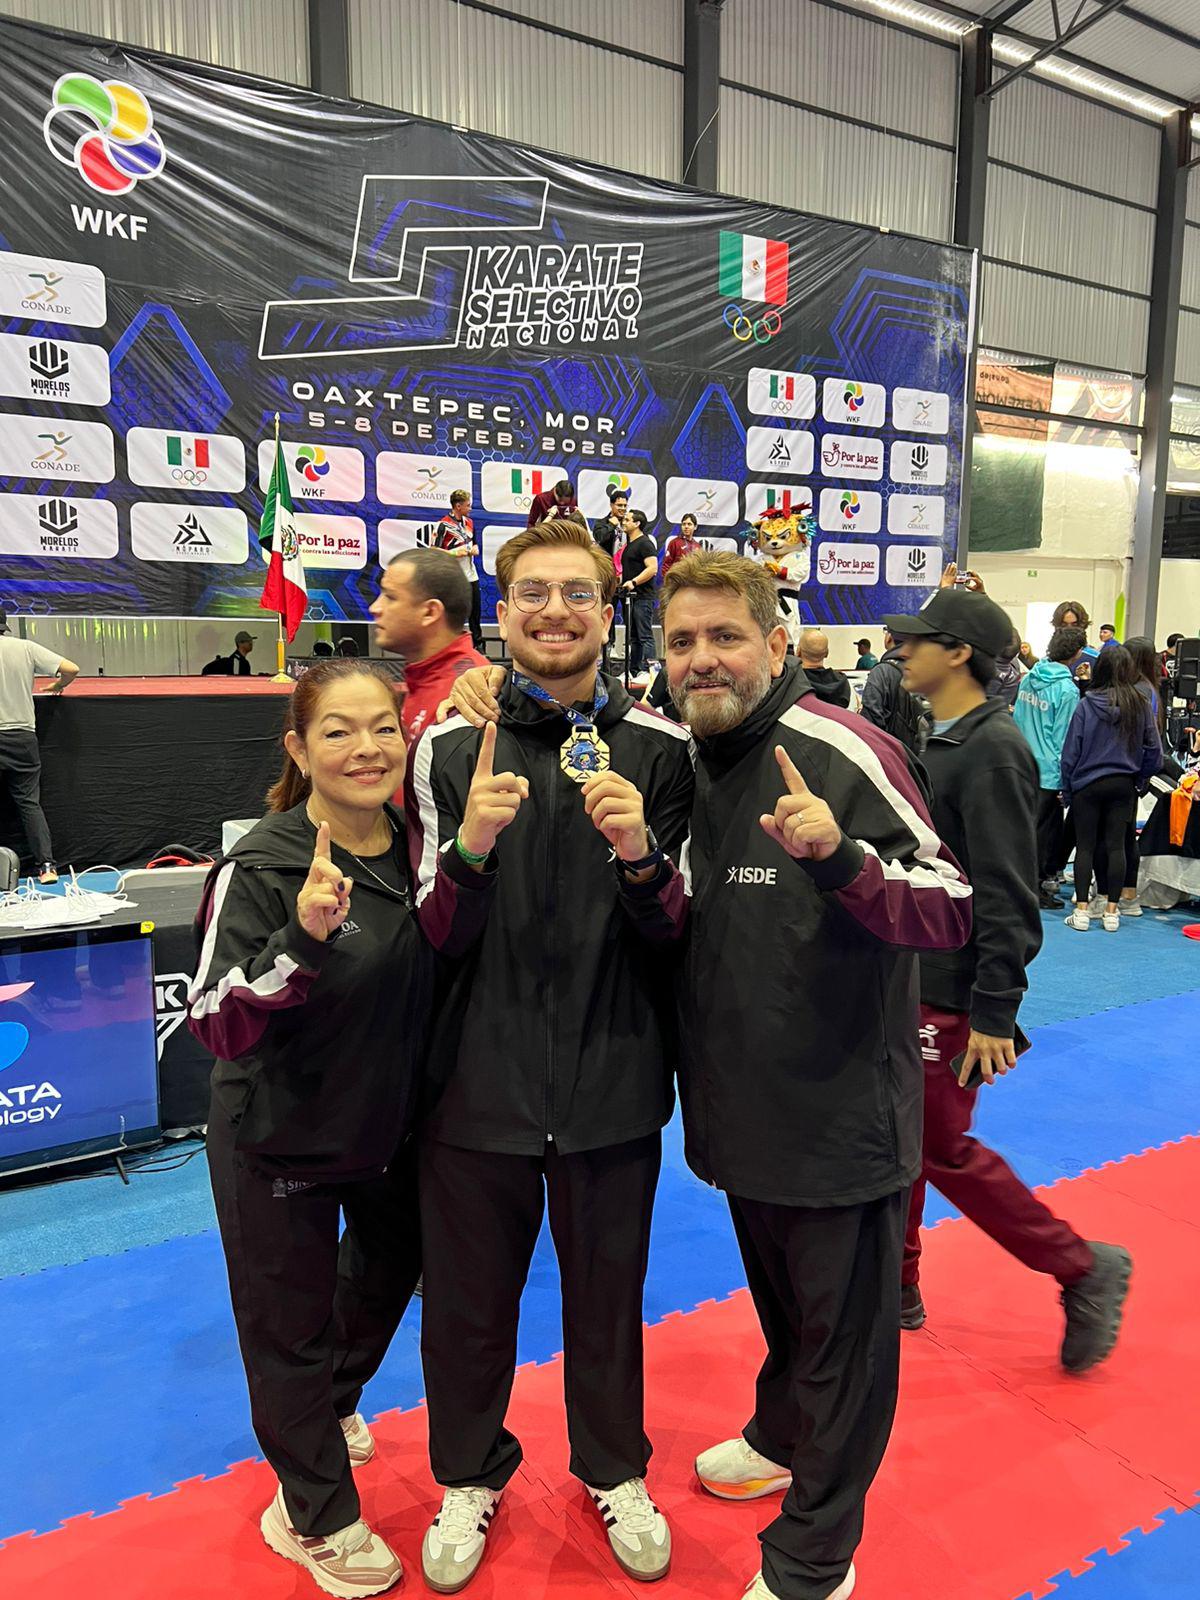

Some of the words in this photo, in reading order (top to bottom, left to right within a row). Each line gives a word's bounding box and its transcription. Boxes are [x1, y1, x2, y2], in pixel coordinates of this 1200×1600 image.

[70, 204, 148, 241] WKF
[472, 243, 644, 293] KARATE
[21, 300, 71, 314] CONADE
[465, 285, 643, 328] SELECTIVO
[466, 318, 639, 349] NACIONAL
[31, 378, 70, 391] MORELOS
[292, 381, 525, 428] OAXTEPEC,
[546, 411, 625, 435] MOR.
[308, 411, 372, 432] 5-8
[392, 421, 433, 439] DE
[453, 427, 524, 448] FEB.
[542, 437, 614, 456] 2026
[841, 451, 855, 461] Por
[857, 452, 863, 462] la
[865, 455, 878, 465] paz
[31, 460, 80, 472] CONADE
[301, 487, 326, 498] WKF
[411, 491, 447, 501] CONADE
[40, 536, 79, 546] MORELOS
[297, 534, 320, 546] Por
[323, 534, 334, 547] la
[338, 538, 360, 550] paz
[837, 559, 851, 568] Por
[853, 559, 859, 568] la
[861, 561, 875, 571] paz
[0, 1103, 62, 1126] logy
